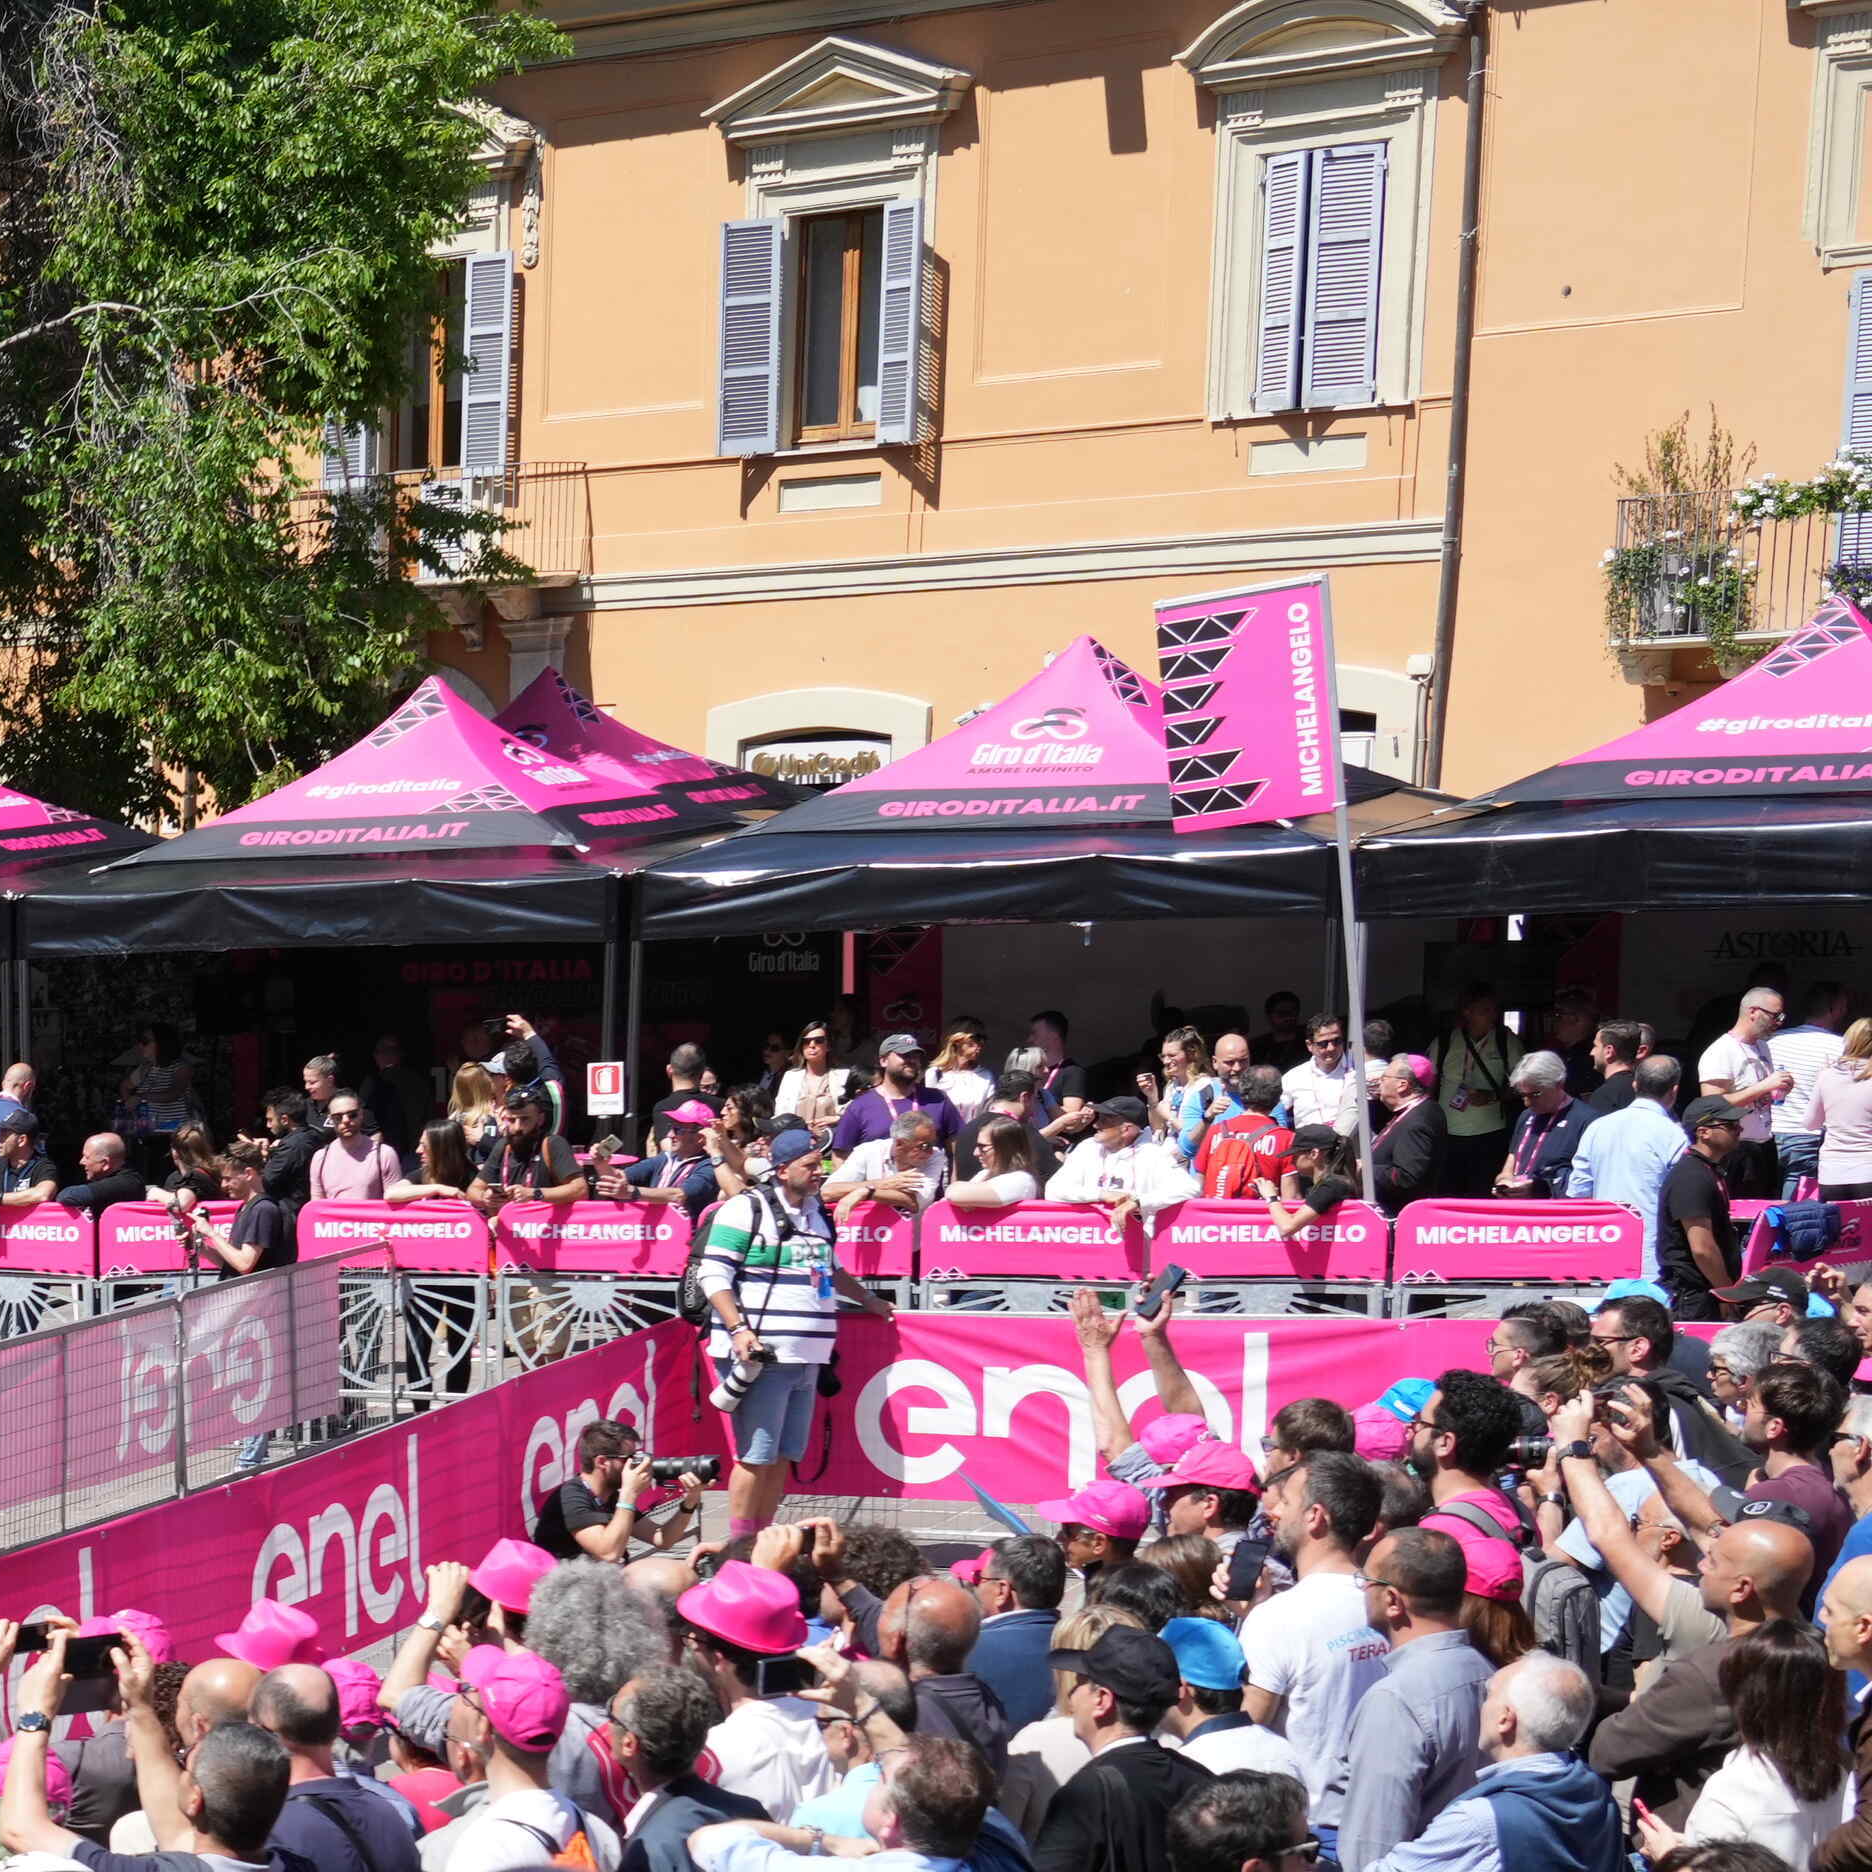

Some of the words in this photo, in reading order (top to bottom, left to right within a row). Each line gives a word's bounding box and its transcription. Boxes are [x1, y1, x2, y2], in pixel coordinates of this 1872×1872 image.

[1287, 602, 1324, 797] MICHELANGELO
[779, 750, 881, 776] UniCredit
[970, 744, 1023, 765] Giro
[1025, 743, 1104, 765] d'Italia
[966, 767, 1024, 775] AMORE
[1026, 766, 1094, 774] INFINITO
[304, 776, 463, 799] #giroditalia
[876, 794, 1146, 818] GIRODITALIA.IT
[239, 820, 471, 848] GIRODITALIA.IT
[1717, 928, 1853, 958] ASTORIA
[747, 952, 779, 974] Giro
[780, 951, 822, 972] d'Italia
[512, 1223, 673, 1241] MICHELANGELO
[1172, 1224, 1367, 1243] MICHELAGELO
[1416, 1225, 1621, 1245] MICHELANGELO
[255, 1433, 428, 1637] enel
